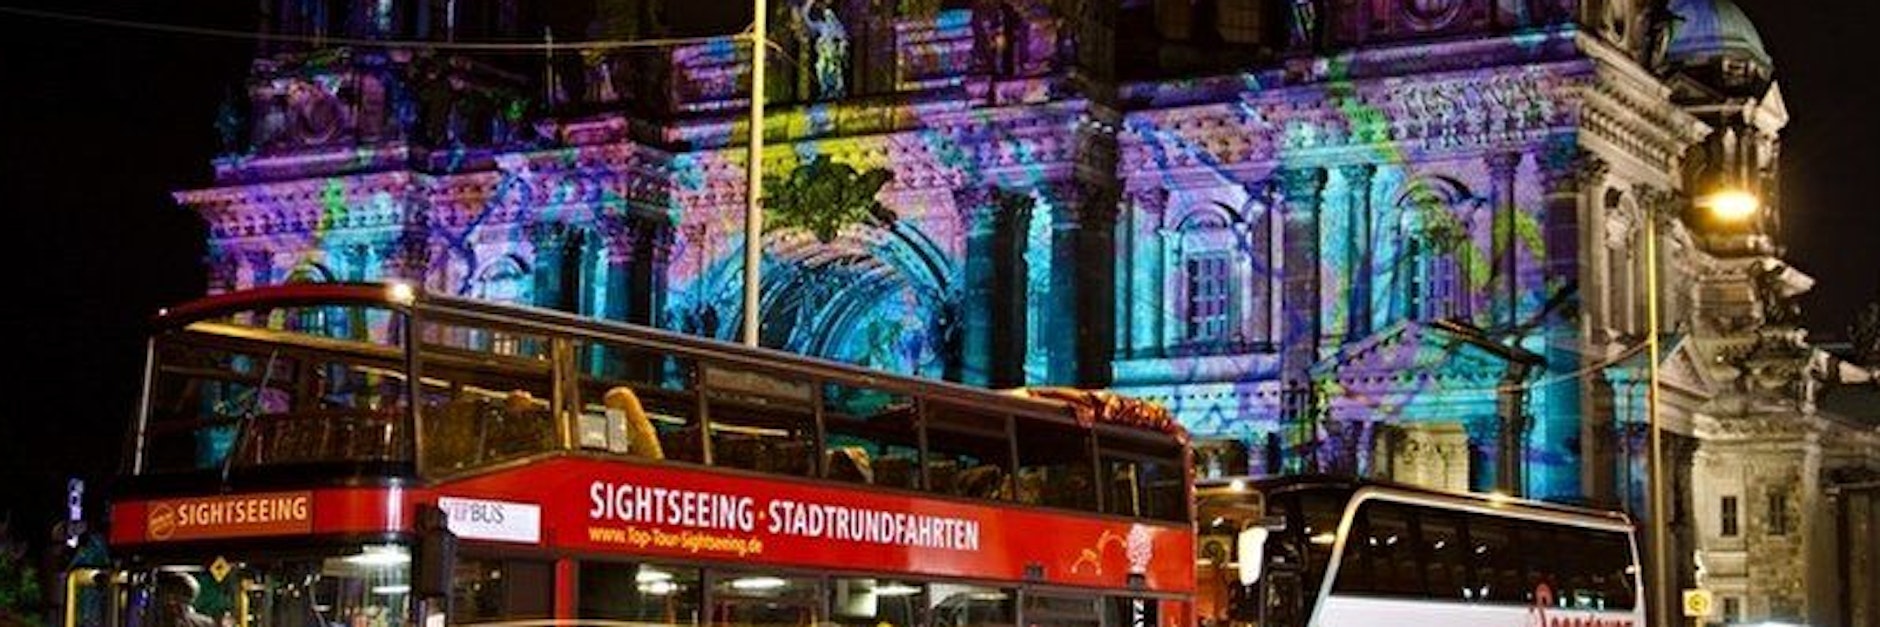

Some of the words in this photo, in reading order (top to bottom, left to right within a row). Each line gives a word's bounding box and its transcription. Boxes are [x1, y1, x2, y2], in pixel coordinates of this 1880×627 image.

[178, 497, 307, 526] SIGHTSEEING
[589, 481, 755, 532] SIGHTSEEING
[768, 500, 980, 550] STADTRUNDFAHRTEN
